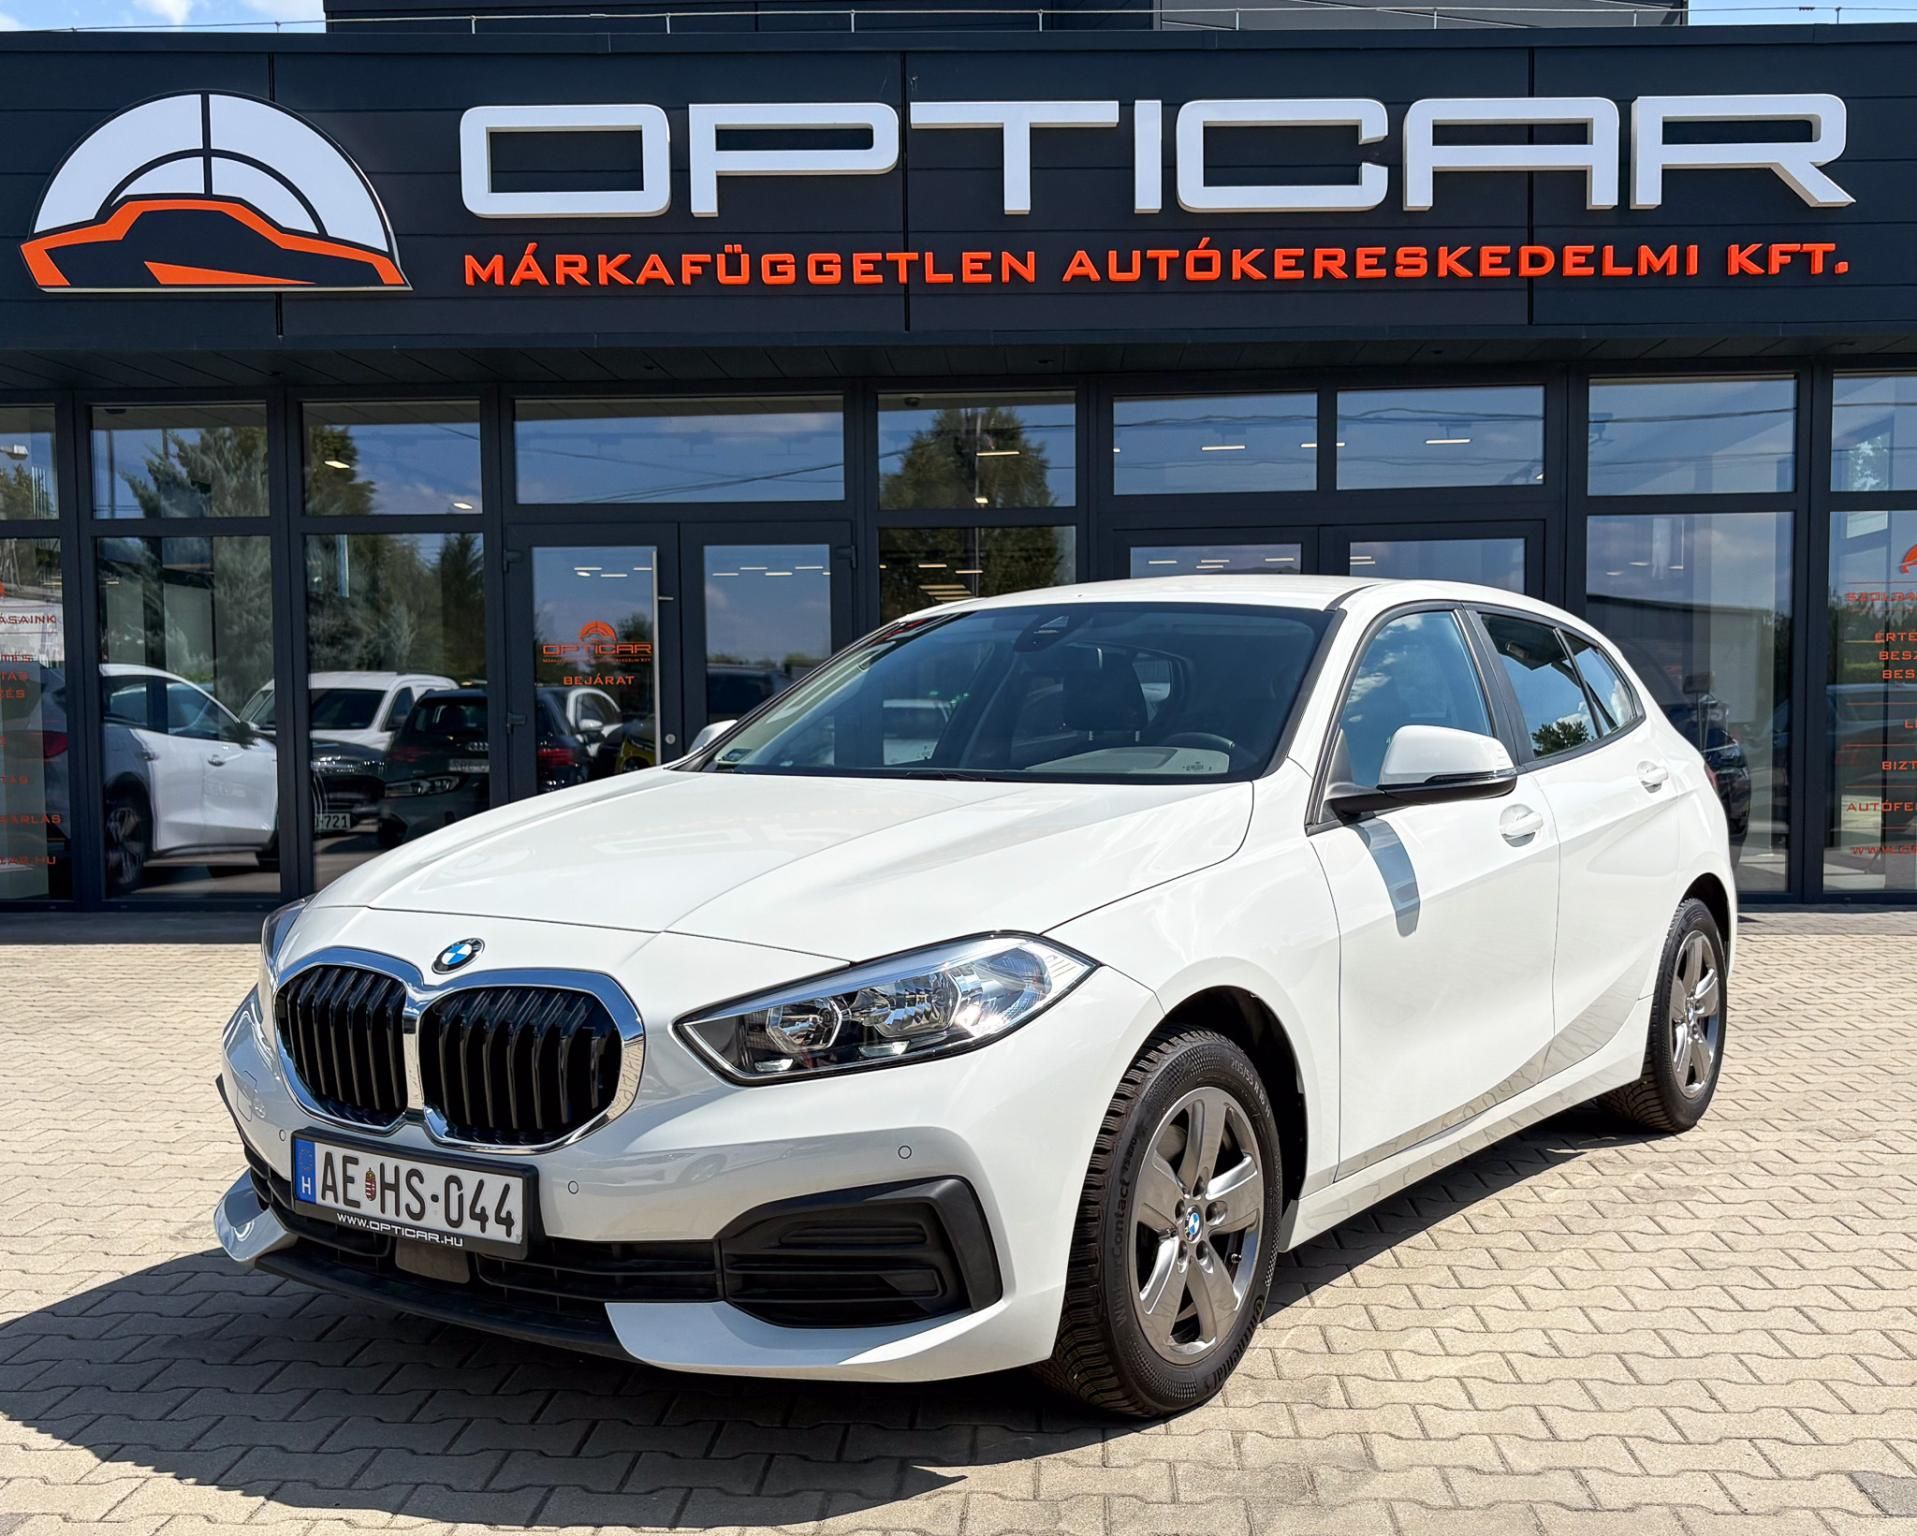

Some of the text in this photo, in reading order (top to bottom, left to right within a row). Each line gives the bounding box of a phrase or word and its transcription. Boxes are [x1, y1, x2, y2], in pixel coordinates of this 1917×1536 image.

[460, 94, 1856, 218] OPTICAR
[464, 237, 1849, 286] MÁRKAFÜGGETLEN AUTÓKERESKEDELMI KFT.
[543, 643, 652, 655] OPTICAR
[563, 673, 635, 686] BEJÁRAT
[302, 1176, 311, 1195] H
[321, 1151, 361, 1209] AE
[336, 1212, 464, 1247] WWW.OPTICAR.HU
